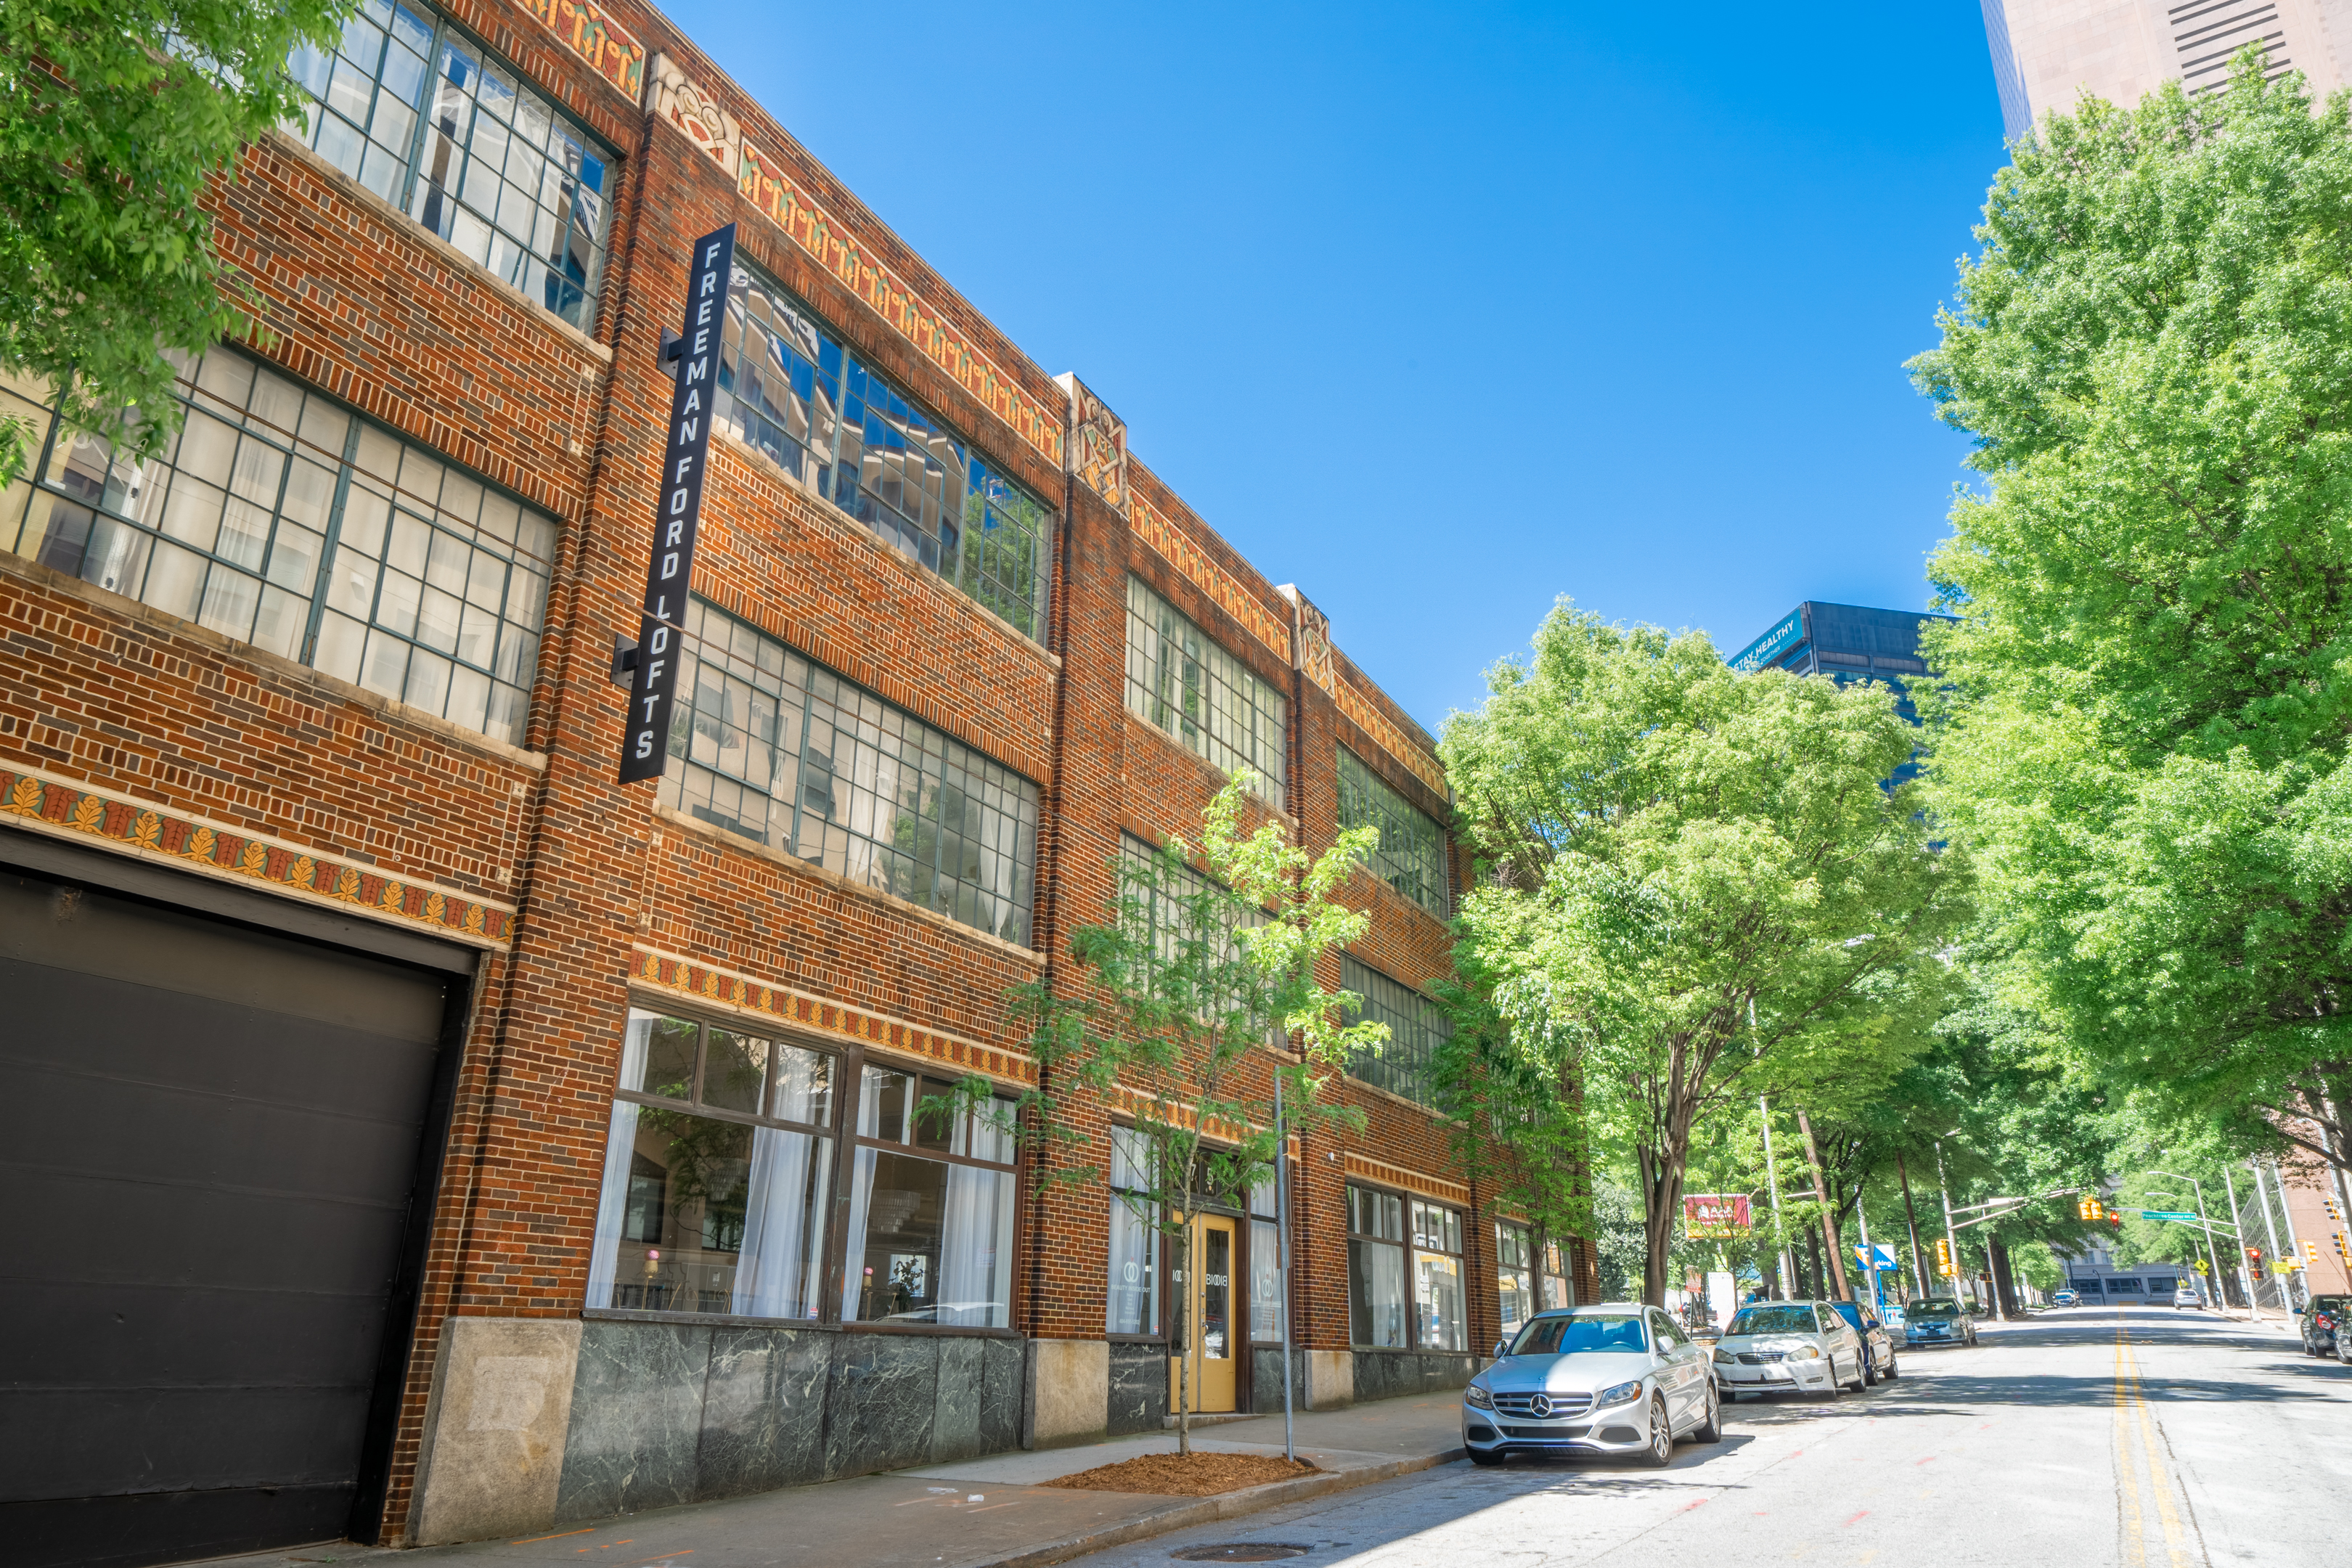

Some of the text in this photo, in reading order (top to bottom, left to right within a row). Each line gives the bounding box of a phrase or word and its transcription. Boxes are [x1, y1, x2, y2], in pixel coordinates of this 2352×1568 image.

[635, 242, 721, 760] FREEMAN FORD LOFTS
[1755, 619, 1794, 657] HEALTHY
